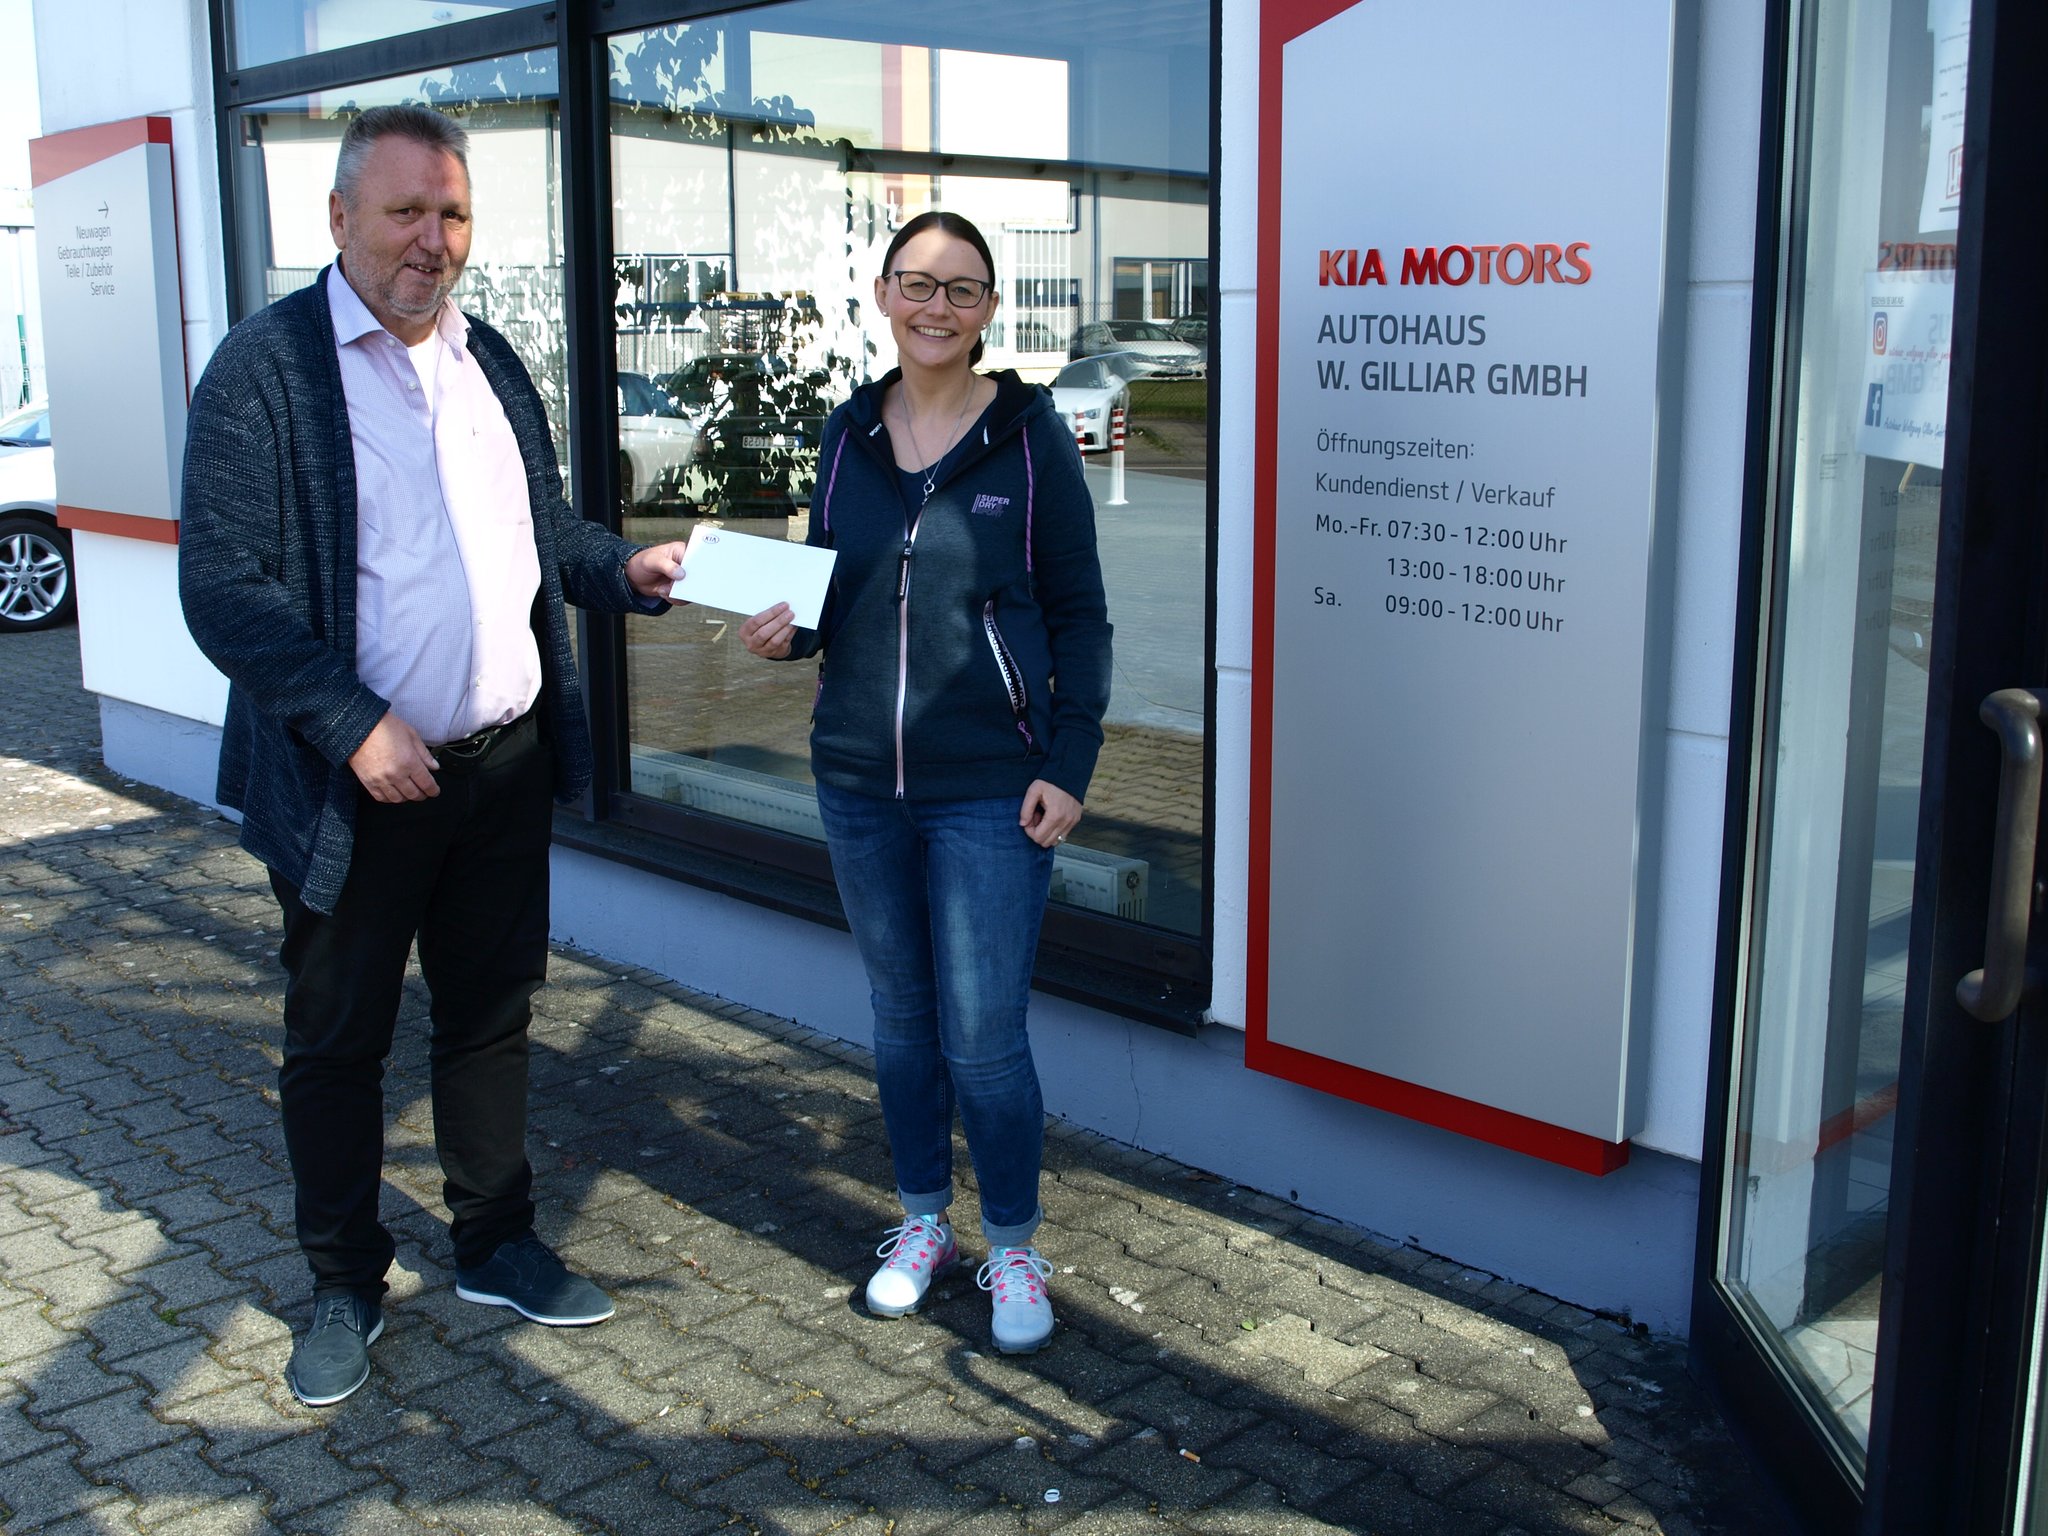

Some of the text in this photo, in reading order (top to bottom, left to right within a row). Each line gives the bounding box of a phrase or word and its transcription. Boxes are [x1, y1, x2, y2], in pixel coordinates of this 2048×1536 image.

[76, 225, 112, 241] Neuwagen
[57, 244, 113, 261] Gebrauchtwagen
[1318, 242, 1593, 287] KIA MOTORS
[65, 263, 80, 278] Teile
[86, 262, 114, 277] Zubehör
[90, 281, 116, 296] Service
[1316, 313, 1487, 346] AUTOHAUS
[1316, 359, 1588, 398] W. GILLIAR GMBH
[1316, 428, 1475, 460] Öffnungszeiten:
[980, 494, 1011, 506] SUPER
[1315, 472, 1556, 508] Kundendienst / Verkauf
[704, 535, 718, 544] KIA
[1387, 519, 1446, 542] 07:30
[1464, 526, 1525, 549] 12:00
[1529, 531, 1568, 554] Uhr
[1387, 557, 1445, 580] 13:00
[1463, 565, 1523, 589] 18:00
[1528, 571, 1566, 594] Uhr
[1313, 586, 1343, 608] Sa.
[1385, 594, 1443, 618] 09:00
[1461, 602, 1521, 627] 12:00
[1526, 609, 1564, 633] Uhr
